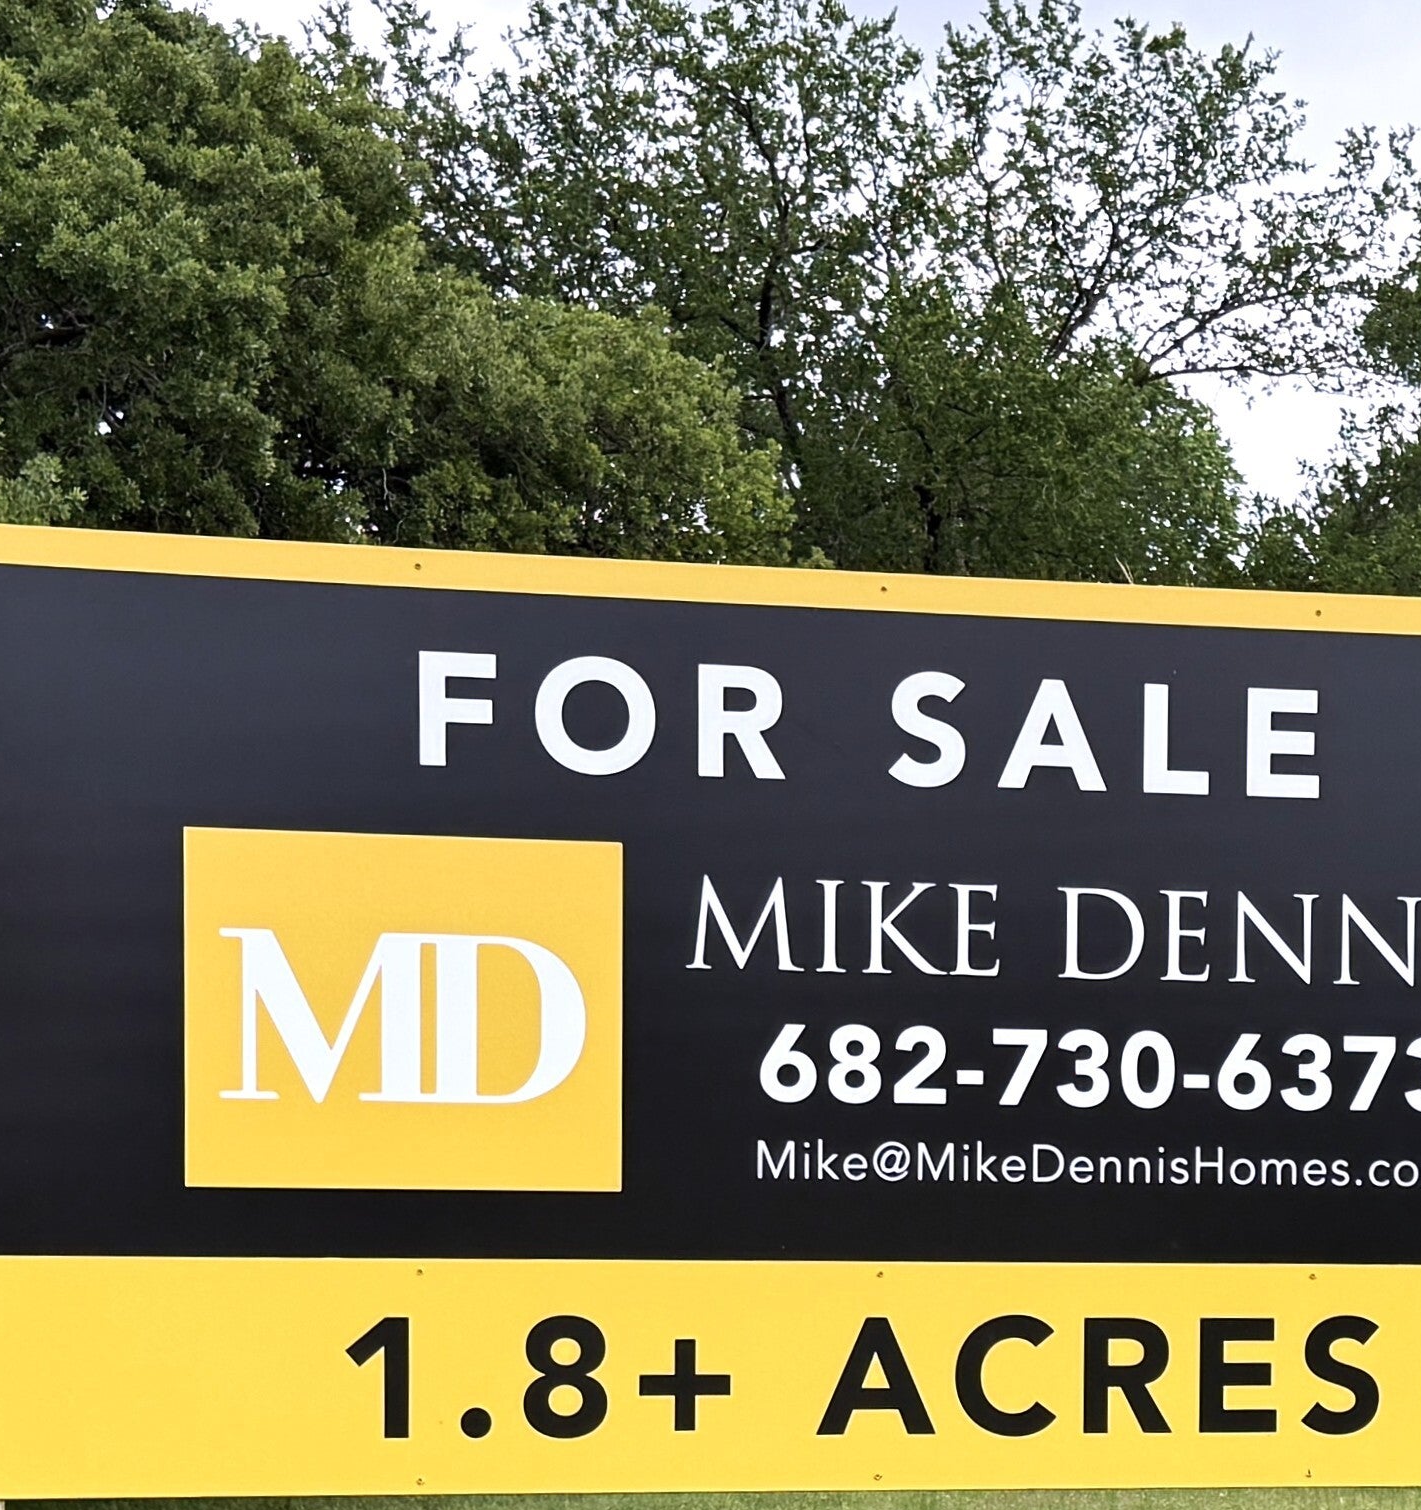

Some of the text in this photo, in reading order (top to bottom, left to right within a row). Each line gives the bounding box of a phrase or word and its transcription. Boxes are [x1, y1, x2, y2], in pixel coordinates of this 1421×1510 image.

[418, 649, 1320, 796] FOR SALE
[685, 873, 1000, 977] MIKE
[218, 926, 587, 1105] MD
[345, 1315, 1380, 1440] 1.8+ ACRES
